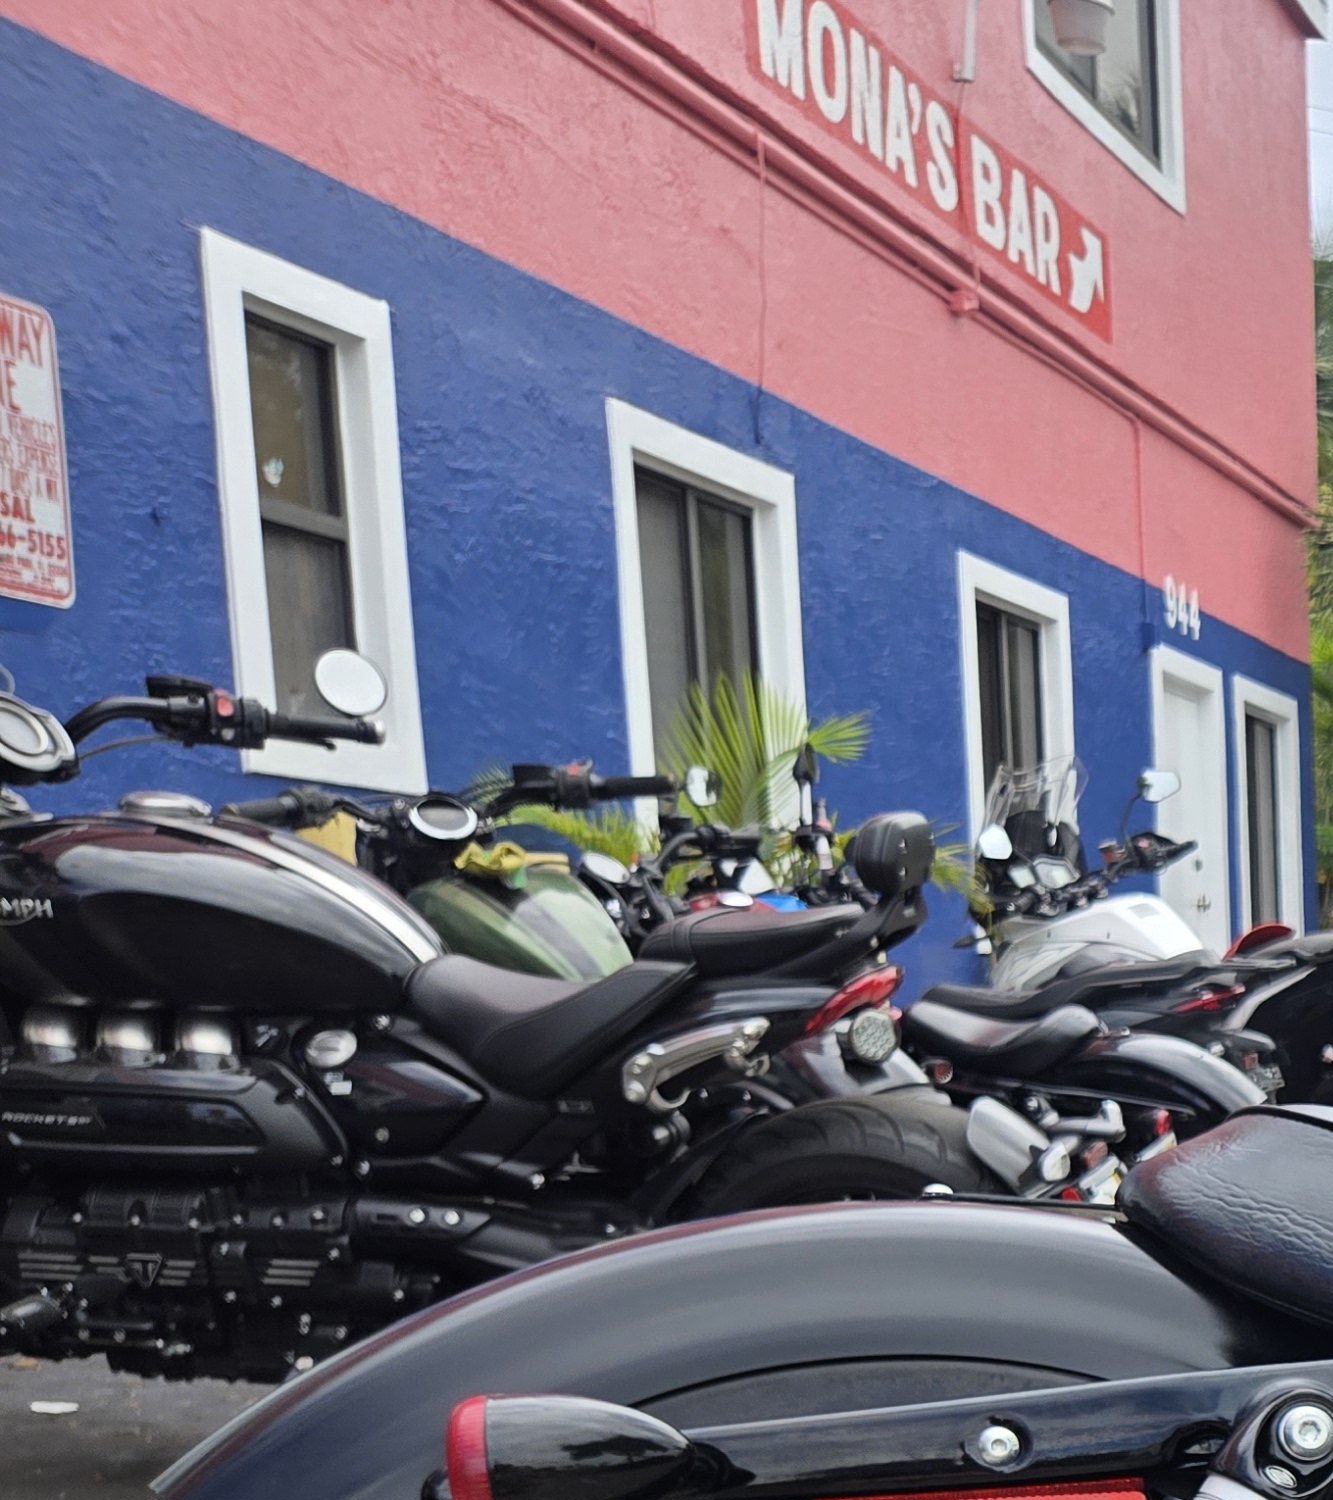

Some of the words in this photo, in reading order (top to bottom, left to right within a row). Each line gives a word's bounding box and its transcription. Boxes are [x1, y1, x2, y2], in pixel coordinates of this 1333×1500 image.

[757, 0, 958, 212] MONA'S
[970, 134, 1061, 296] BAR
[1163, 573, 1200, 640] 944
